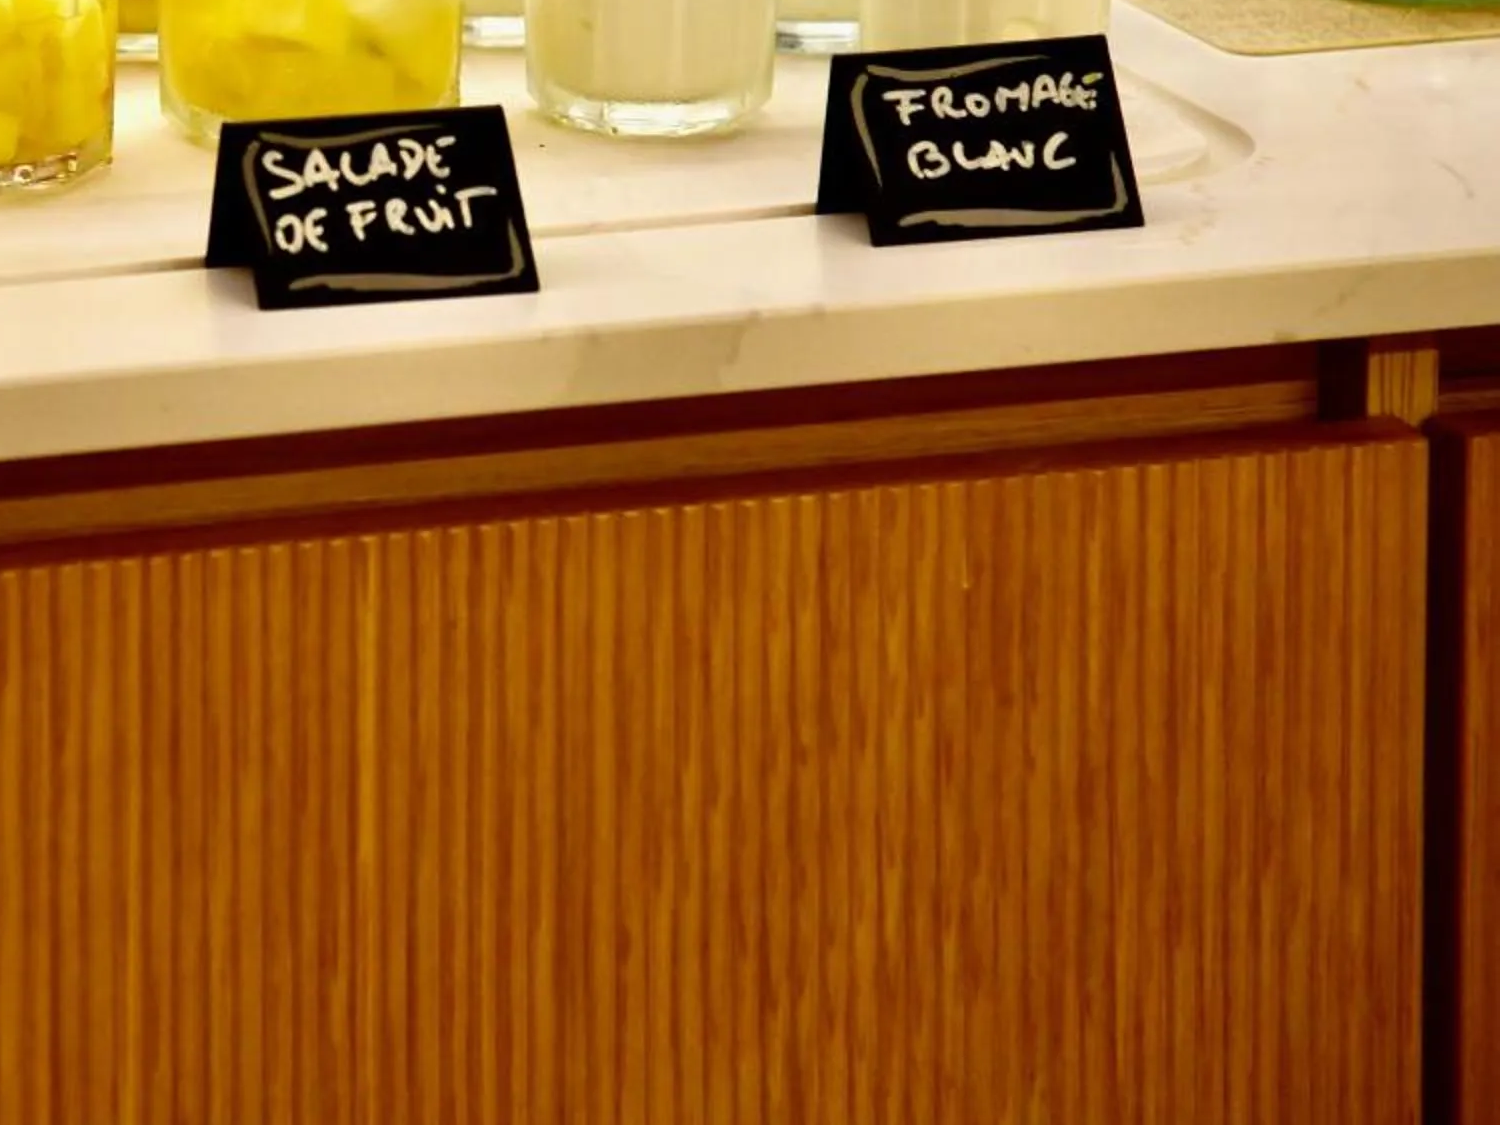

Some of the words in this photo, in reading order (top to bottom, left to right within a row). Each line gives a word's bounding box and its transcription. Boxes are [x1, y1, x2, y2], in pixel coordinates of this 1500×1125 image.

[262, 136, 456, 199] SALADE
[907, 132, 1076, 179] BLANC
[275, 208, 328, 253] DE
